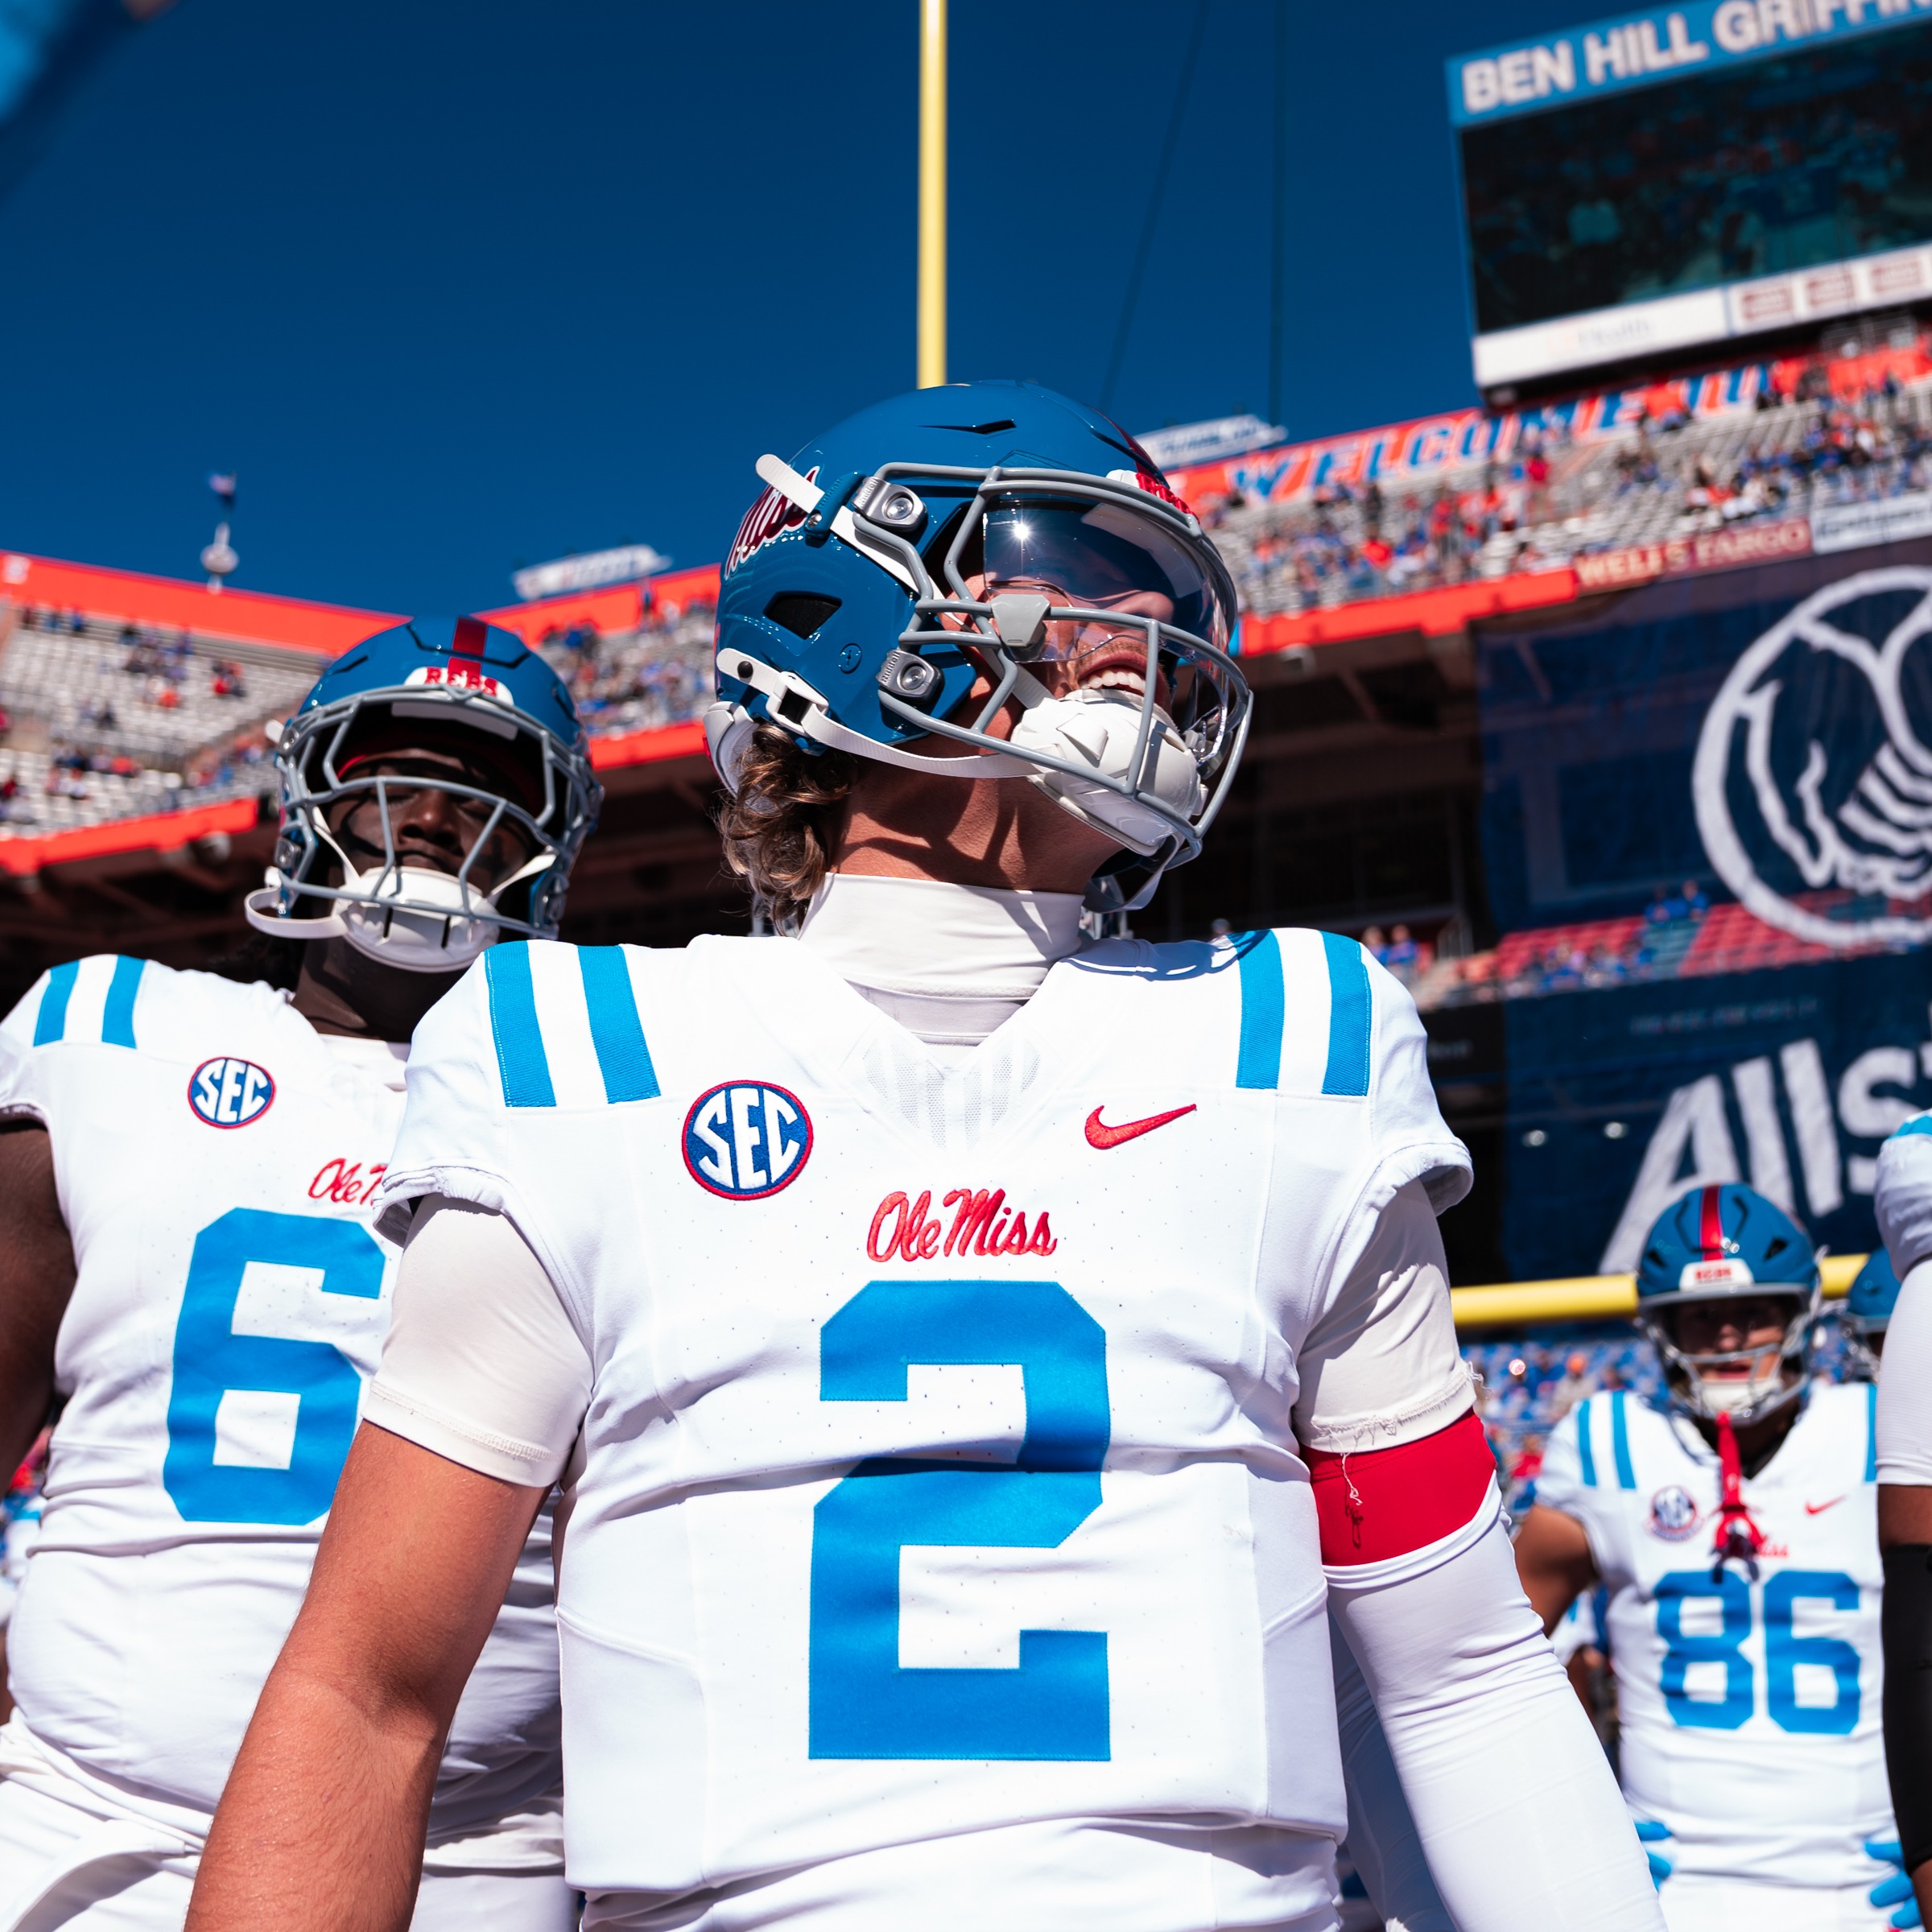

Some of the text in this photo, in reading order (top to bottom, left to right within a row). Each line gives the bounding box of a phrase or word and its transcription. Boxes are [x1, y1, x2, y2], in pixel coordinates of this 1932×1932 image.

[1462, 0, 1932, 114] BEN HILL GRIF
[1578, 541, 1689, 588] WELLS
[1695, 521, 1807, 567] FARGO
[423, 666, 498, 697] REBS
[194, 1059, 269, 1123] SEC
[692, 1087, 801, 1189] SEC
[1600, 1001, 1932, 1275] Alls
[308, 1158, 363, 1203] Ole
[867, 1188, 1058, 1262] Ole Miss
[163, 1207, 386, 1526] 6
[808, 1280, 1112, 1761] 2
[1653, 1570, 1861, 1735] 86
